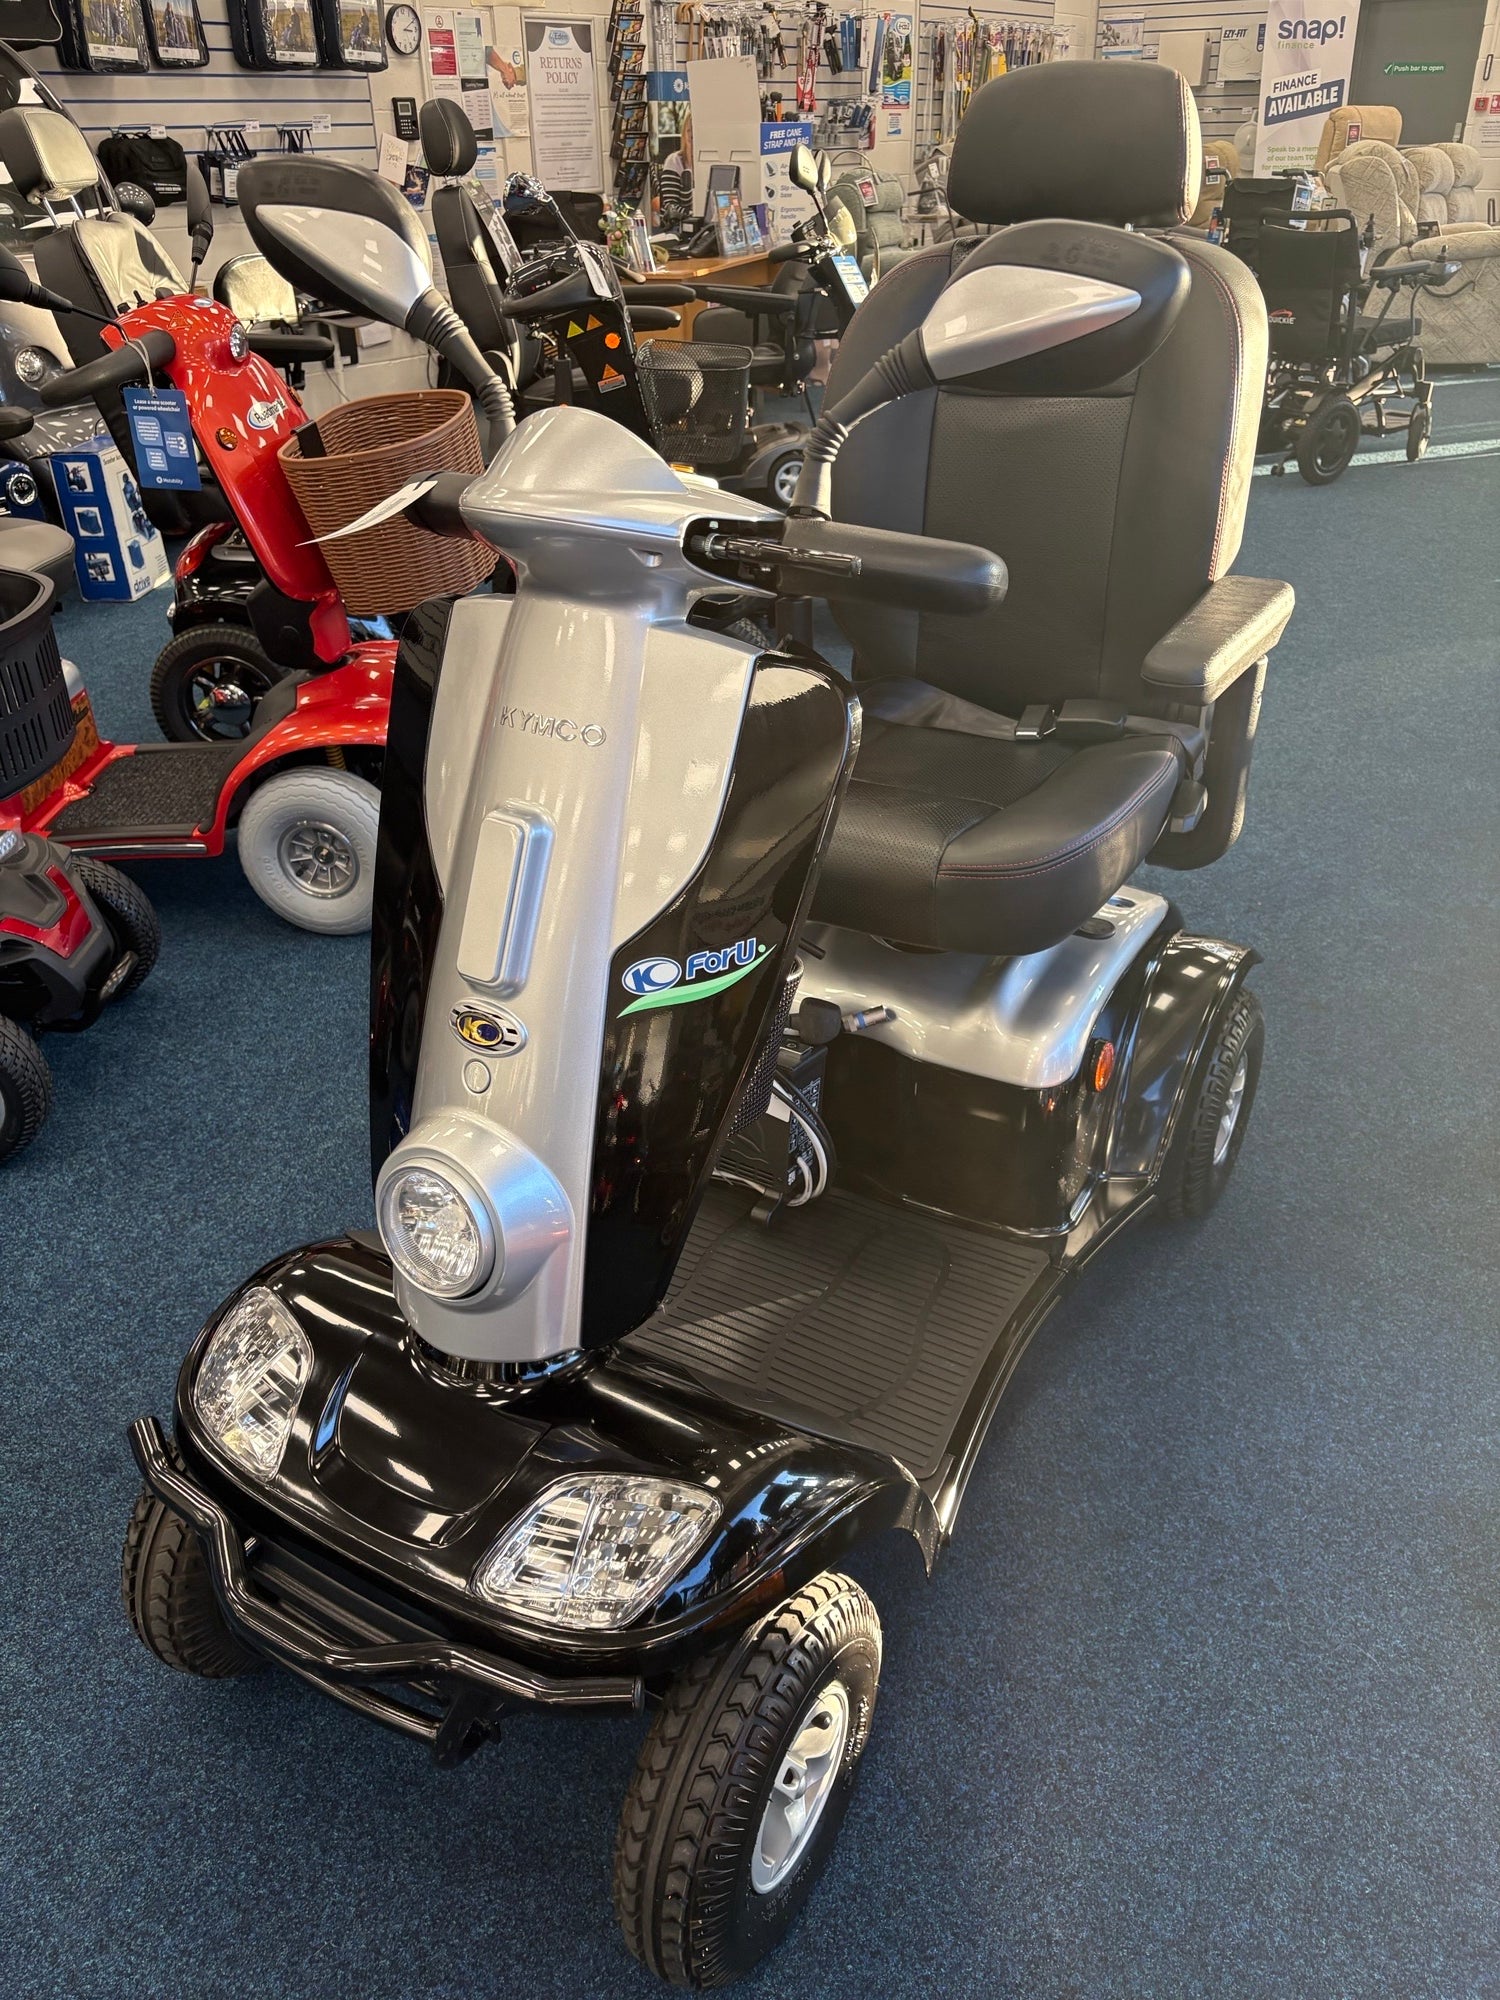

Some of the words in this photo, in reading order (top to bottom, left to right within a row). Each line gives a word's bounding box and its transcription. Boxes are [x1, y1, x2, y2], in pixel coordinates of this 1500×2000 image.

[1223, 28, 1248, 38] EZY-FIT
[1278, 16, 1346, 45] snap!
[1277, 41, 1315, 49] finance
[539, 56, 583, 69] RETURNS
[545, 71, 579, 84] POLICY
[1273, 73, 1318, 93] FINANCE
[1268, 86, 1339, 117] AVAILABLE
[770, 130, 786, 139] FREE
[786, 128, 803, 137] CANE
[763, 140, 783, 150] STRAP
[783, 139, 797, 147] AND
[177, 436, 187, 450] 3
[134, 576, 151, 592] drive
[500, 705, 606, 747] KYMCO
[686, 938, 756, 980] ForU
